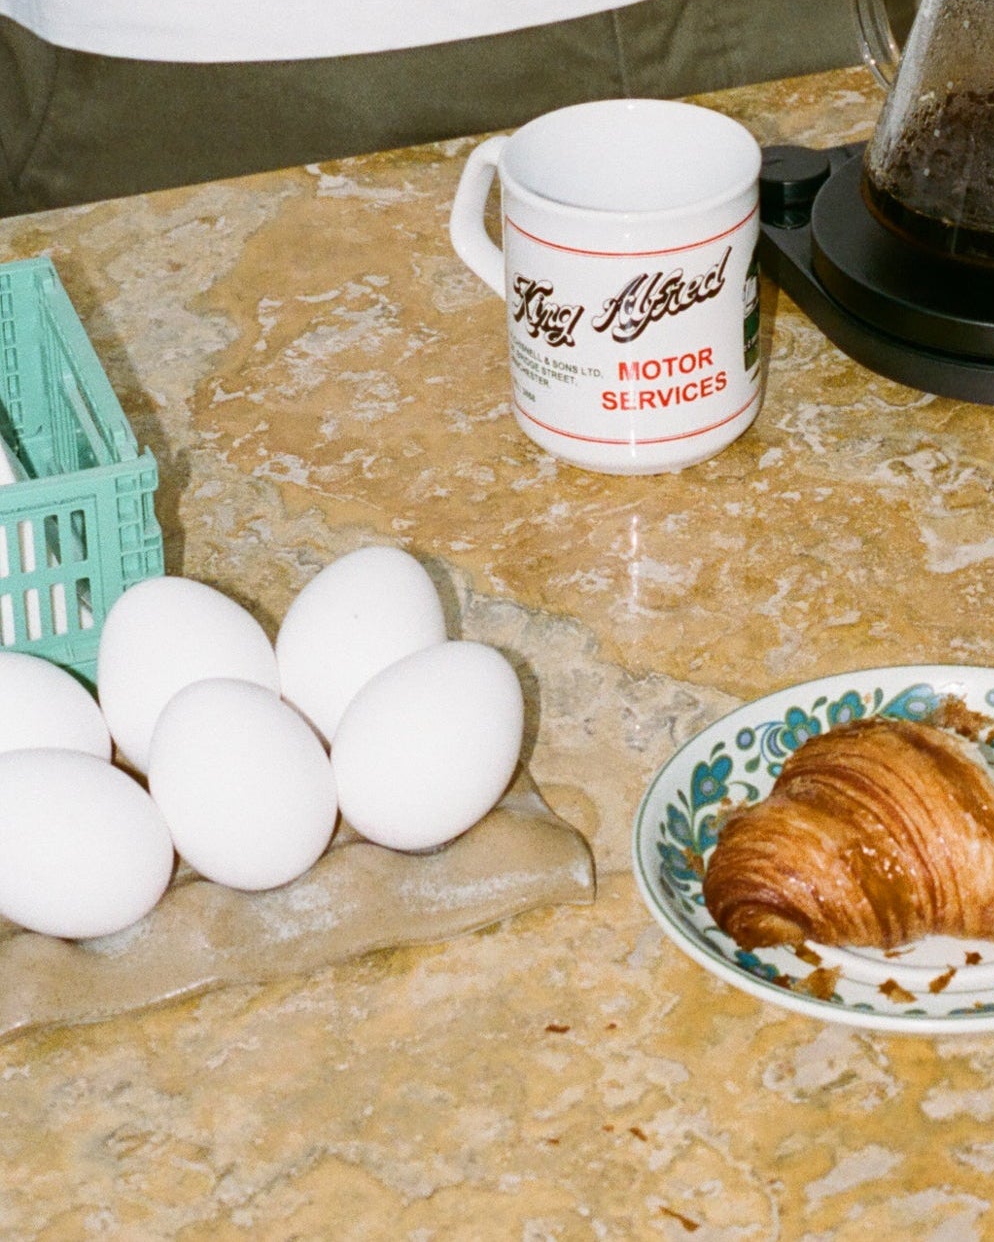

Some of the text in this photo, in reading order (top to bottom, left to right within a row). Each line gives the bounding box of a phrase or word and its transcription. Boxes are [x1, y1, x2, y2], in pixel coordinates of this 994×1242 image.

[513, 246, 733, 347] King Alfred
[544, 356, 550, 365] &
[552, 359, 578, 374] SONS
[618, 347, 713, 381] MOTOR
[602, 371, 727, 410] SERVICES
